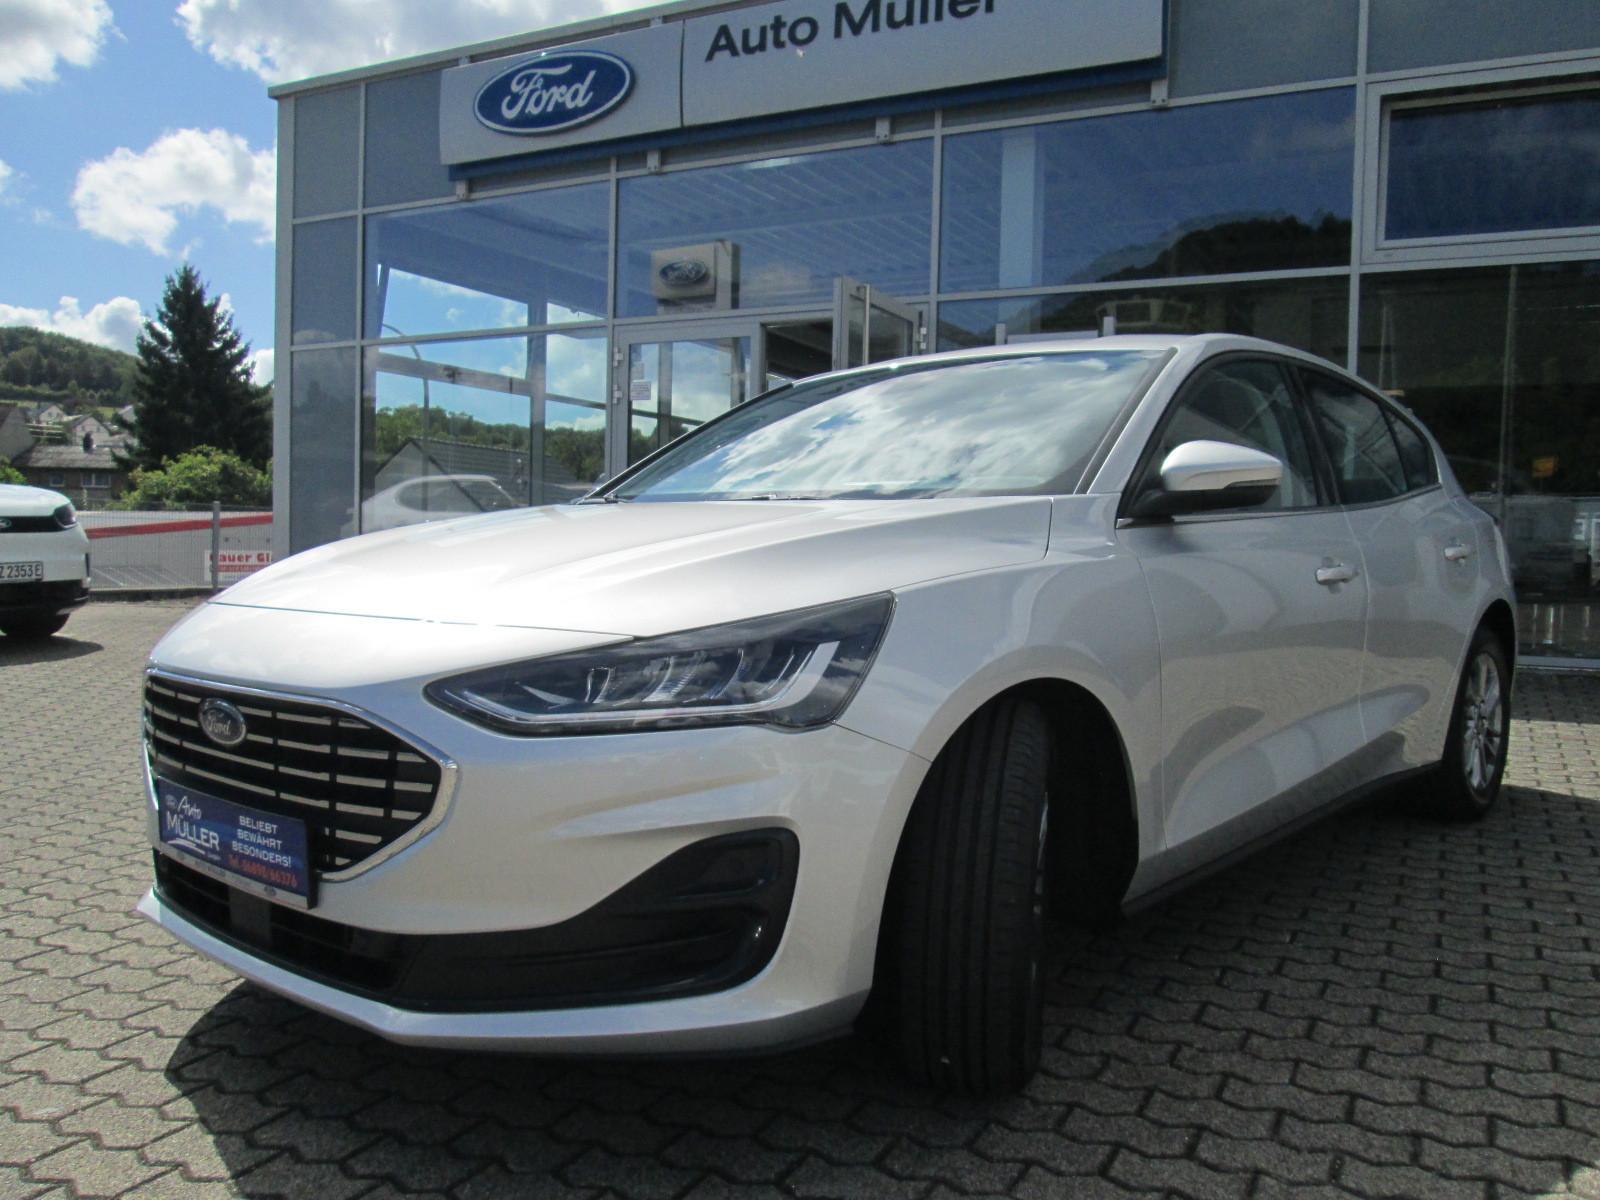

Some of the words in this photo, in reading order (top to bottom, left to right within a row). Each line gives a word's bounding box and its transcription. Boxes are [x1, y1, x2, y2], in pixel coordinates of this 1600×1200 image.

[705, 15, 819, 62] Auto
[501, 64, 596, 119] Ford
[167, 810, 220, 851] MÜLLER
[236, 828, 282, 850] BEWÄHRT
[239, 815, 277, 834] BELIEBT
[231, 840, 292, 868] BESONDERS!
